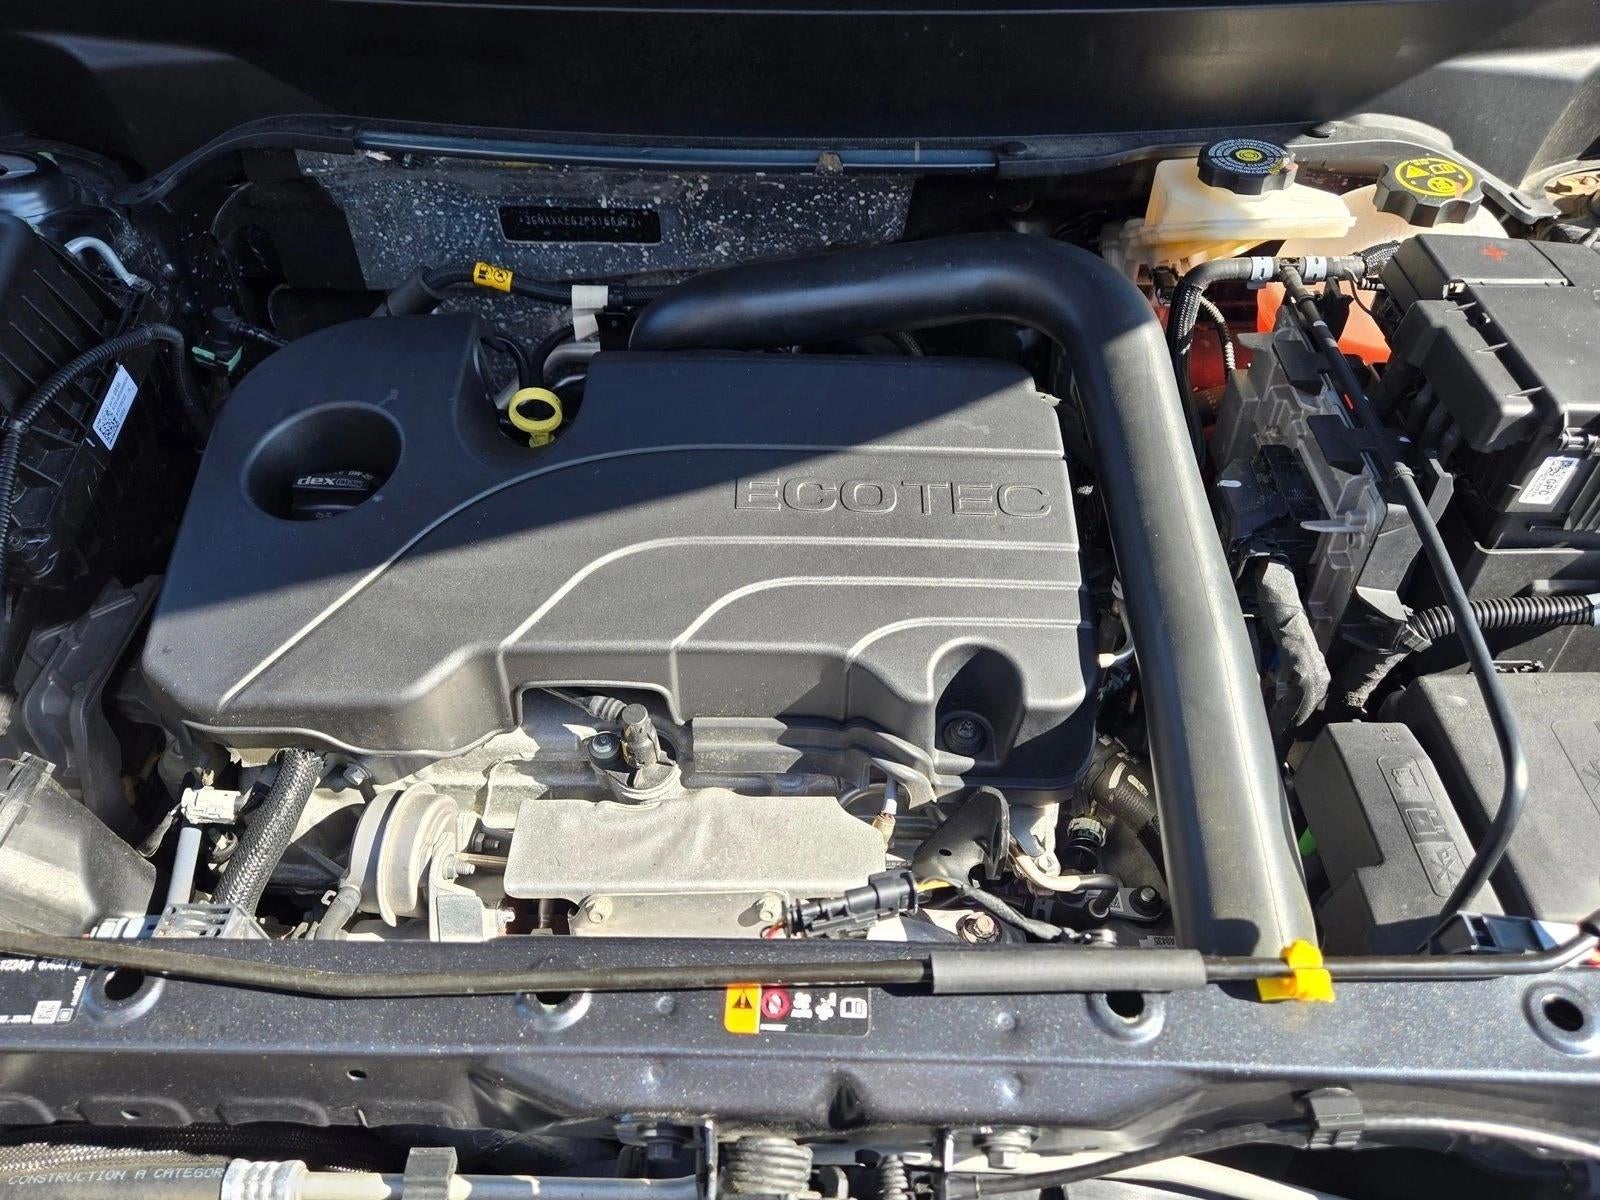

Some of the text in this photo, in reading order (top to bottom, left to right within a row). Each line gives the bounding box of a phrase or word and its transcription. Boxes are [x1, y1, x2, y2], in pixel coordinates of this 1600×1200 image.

[734, 476, 1052, 518] ECOTEC
[8, 1167, 224, 1185] CONSTRUCTION A CATEGOR
